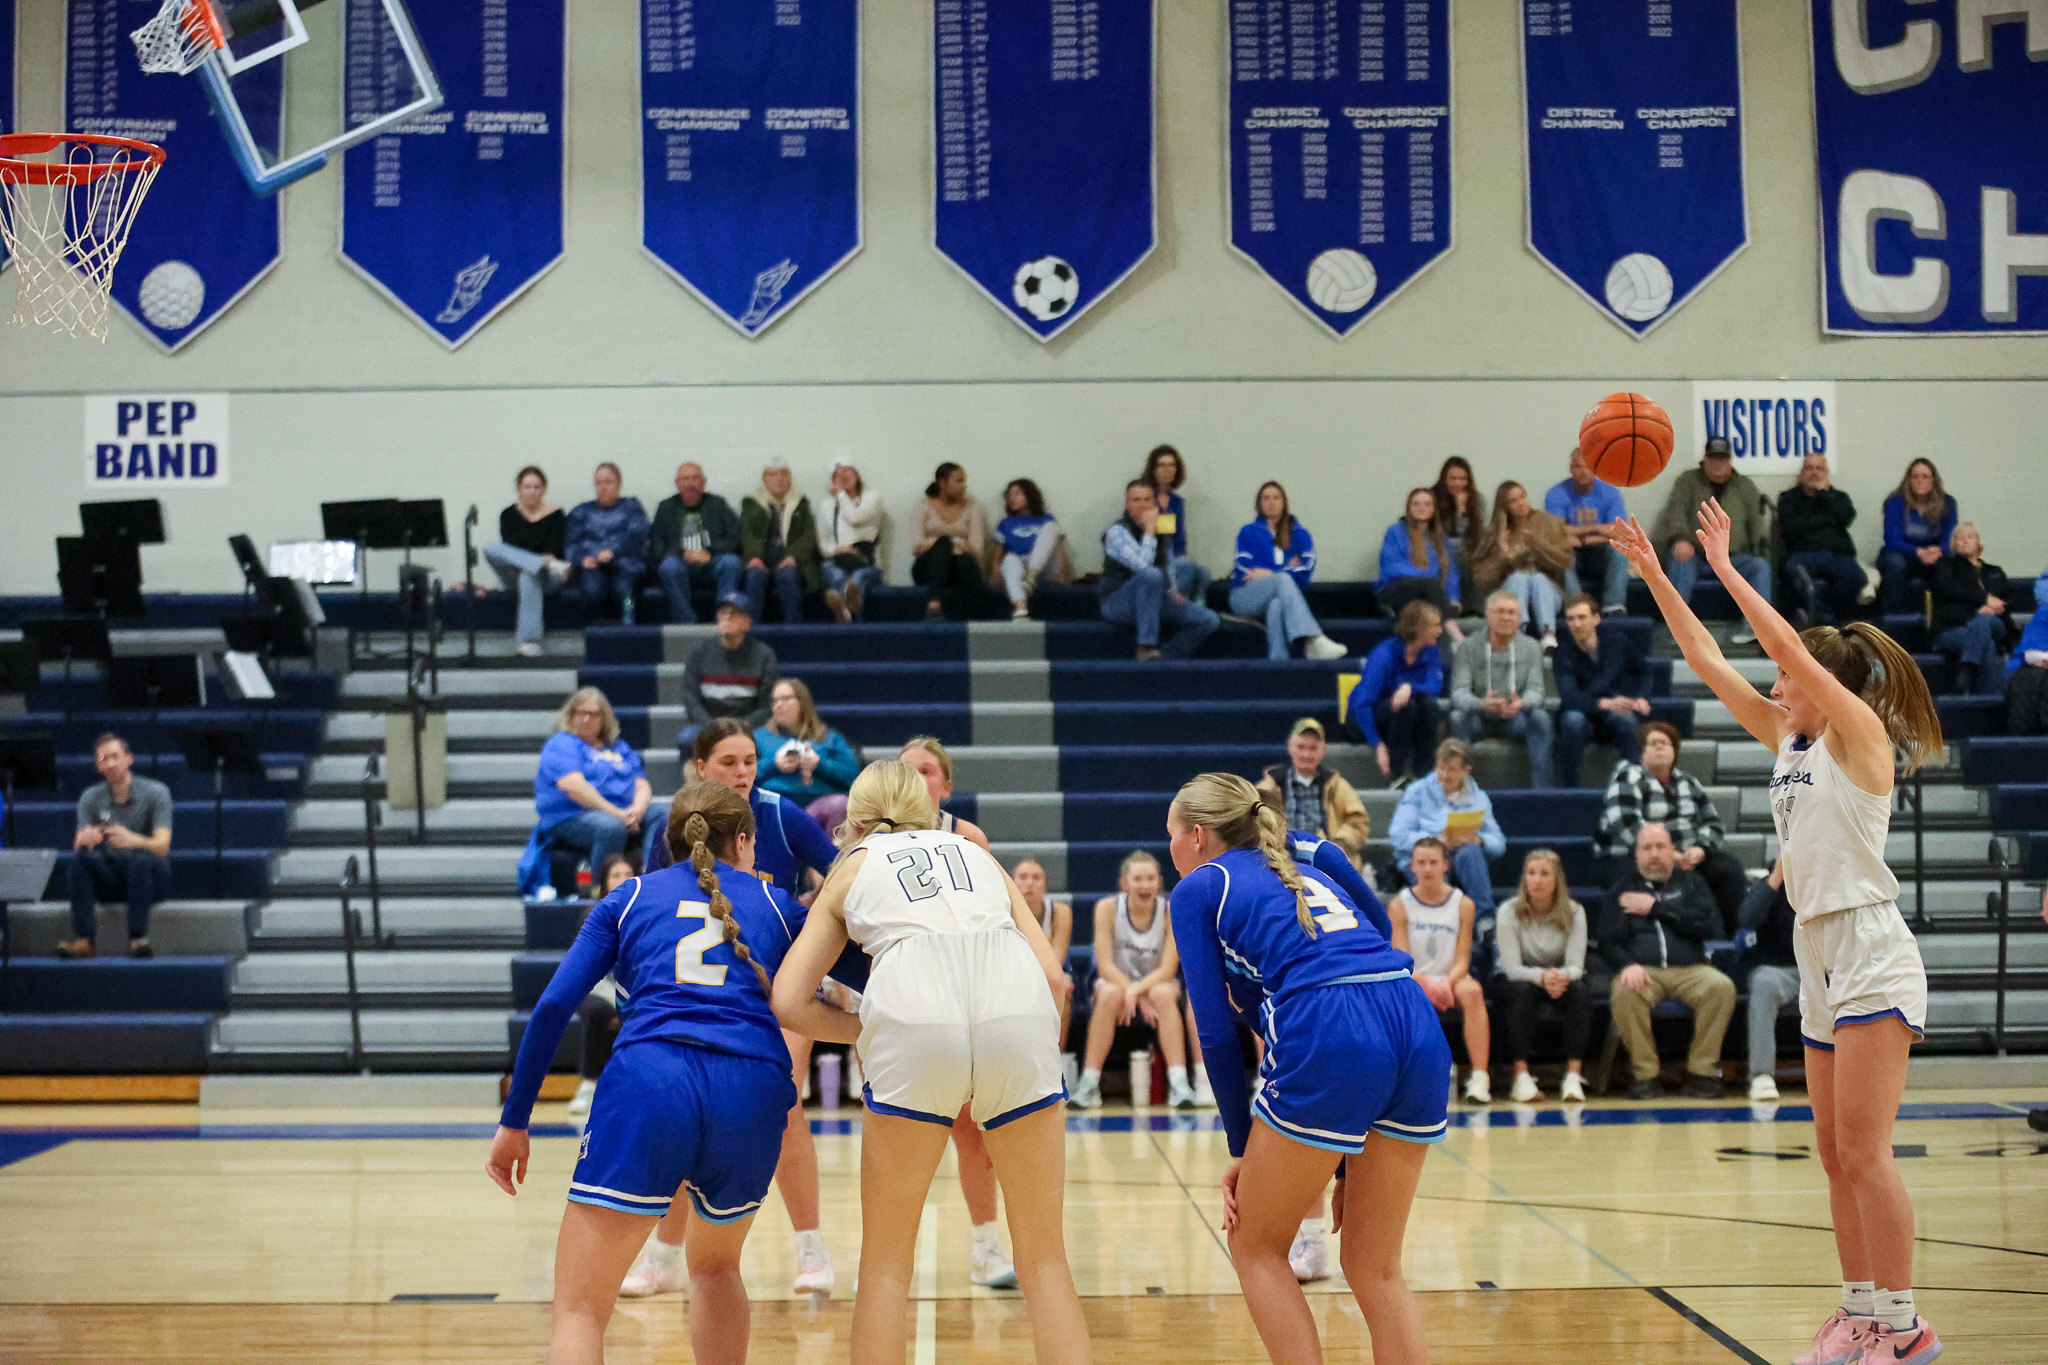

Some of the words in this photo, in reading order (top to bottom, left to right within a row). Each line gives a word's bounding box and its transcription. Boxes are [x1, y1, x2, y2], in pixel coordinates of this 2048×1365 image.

[465, 111, 547, 122] COMBINED
[647, 108, 750, 120] CONFERENCE
[765, 107, 848, 119] COMBINED
[1252, 107, 1321, 117] DISTRICT
[1344, 106, 1448, 117] CONFERENCE
[1547, 108, 1616, 118] DISTRICT
[1636, 107, 1736, 119] CONFERENCE
[464, 122, 508, 133] TEAM
[509, 123, 549, 134] TITLE
[656, 119, 740, 131] CHAMPION
[764, 119, 809, 130] TEAM
[811, 119, 850, 130] TITLE
[1244, 119, 1330, 129] CHAMPION
[1354, 118, 1439, 129] CHAMPION
[1541, 119, 1624, 130] CHAMPION
[1647, 118, 1727, 130] CHAMPION
[118, 402, 196, 436] PEP
[1704, 398, 1826, 457] VISITORS
[96, 443, 217, 479] BAND
[887, 844, 973, 902] 21
[675, 900, 729, 985] 2
